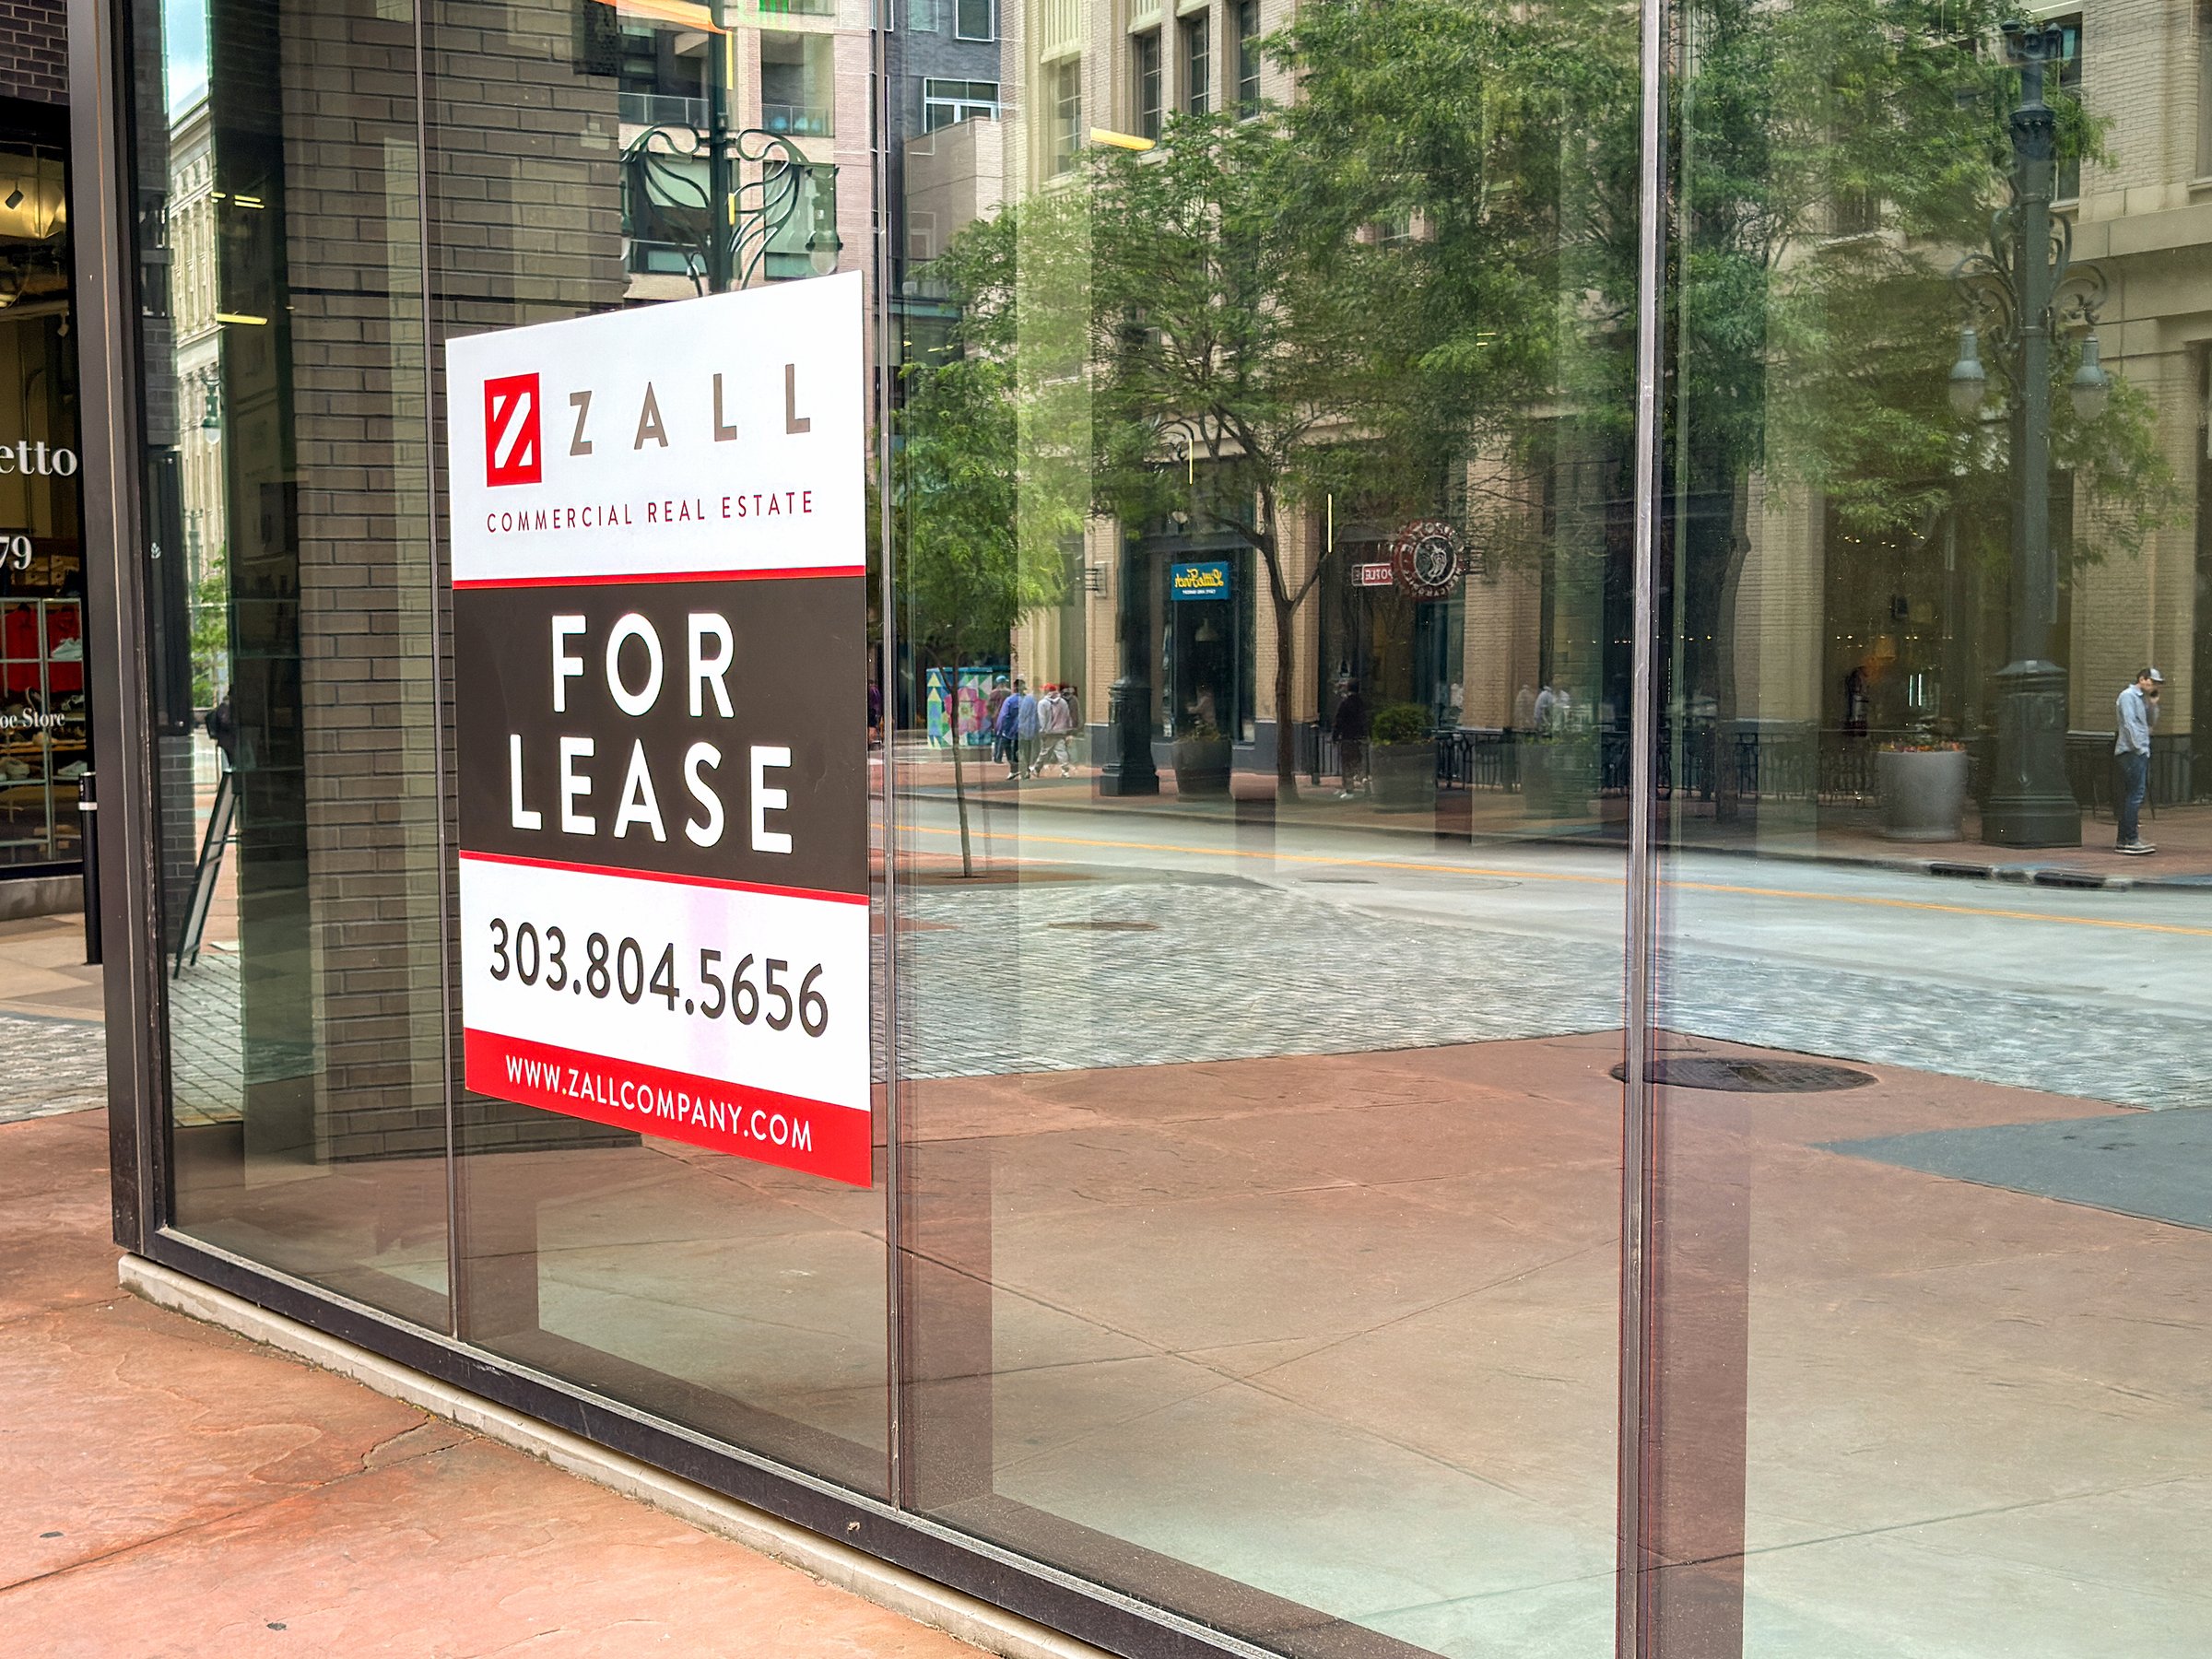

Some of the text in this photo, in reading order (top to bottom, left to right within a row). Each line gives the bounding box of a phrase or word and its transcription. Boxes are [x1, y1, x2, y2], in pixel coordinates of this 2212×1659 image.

[569, 363, 811, 457] ZALL
[487, 490, 813, 534] COMMERCIAL REAL ESTATE
[551, 612, 735, 718] FOR
[22, 707, 66, 728] Store
[510, 734, 794, 854] LEASE
[489, 917, 829, 1038] 303.804.5656
[505, 1054, 812, 1152] WWW.ZALLCOMPANY.COM
